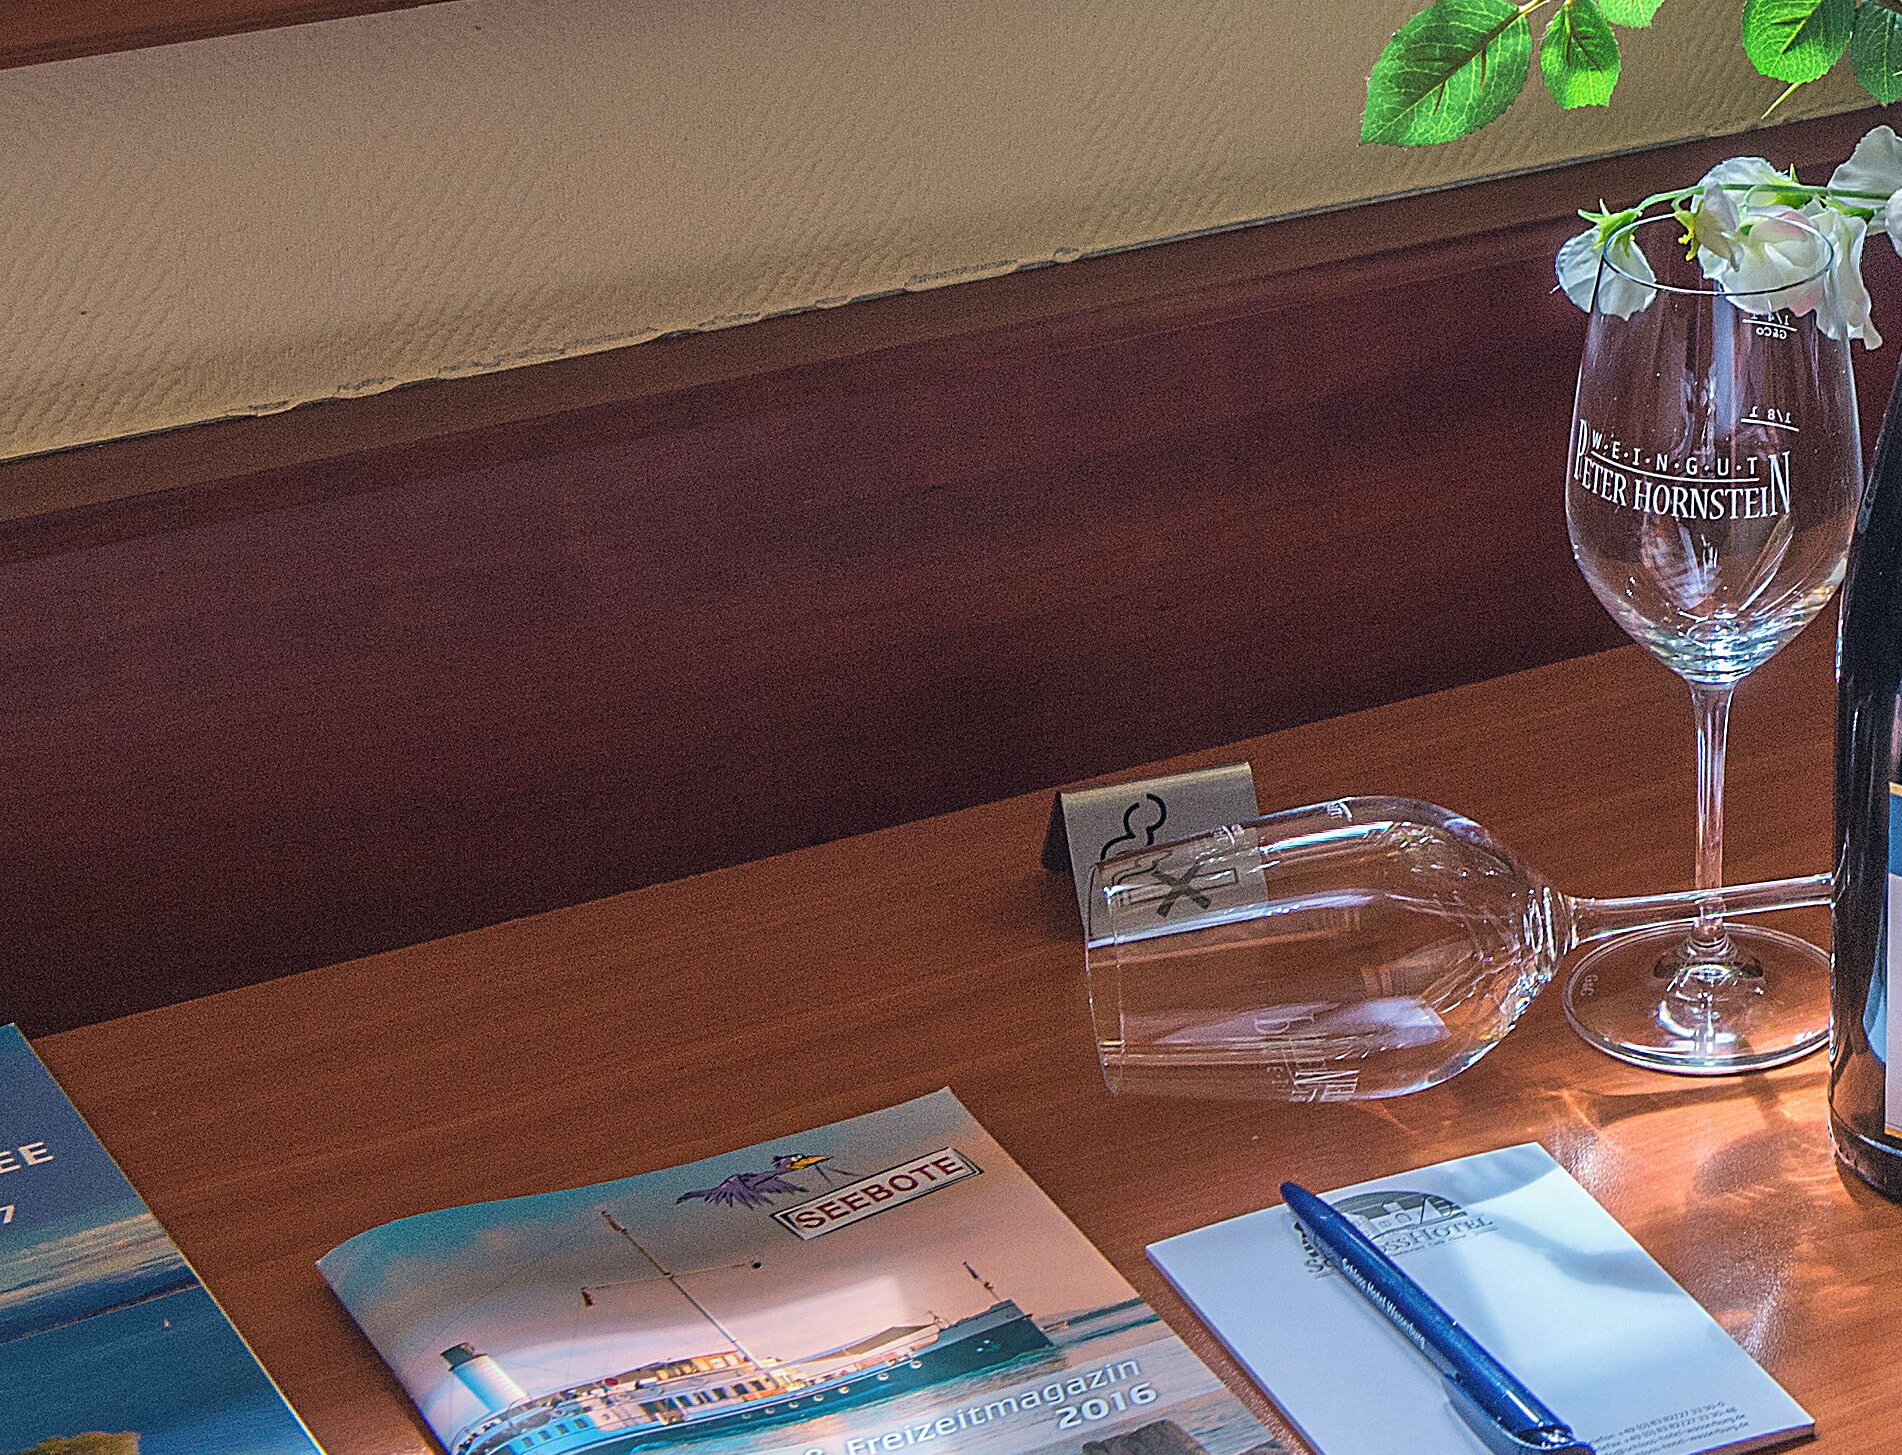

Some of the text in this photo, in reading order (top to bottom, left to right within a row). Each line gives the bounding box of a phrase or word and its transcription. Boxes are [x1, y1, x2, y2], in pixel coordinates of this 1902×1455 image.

[1573, 419, 1790, 520] PETER HORNSTEIN
[795, 1156, 964, 1229] SEEBOTE
[846, 1358, 1142, 1455] Freizeitmagazin
[1055, 1381, 1159, 1431] 2016
